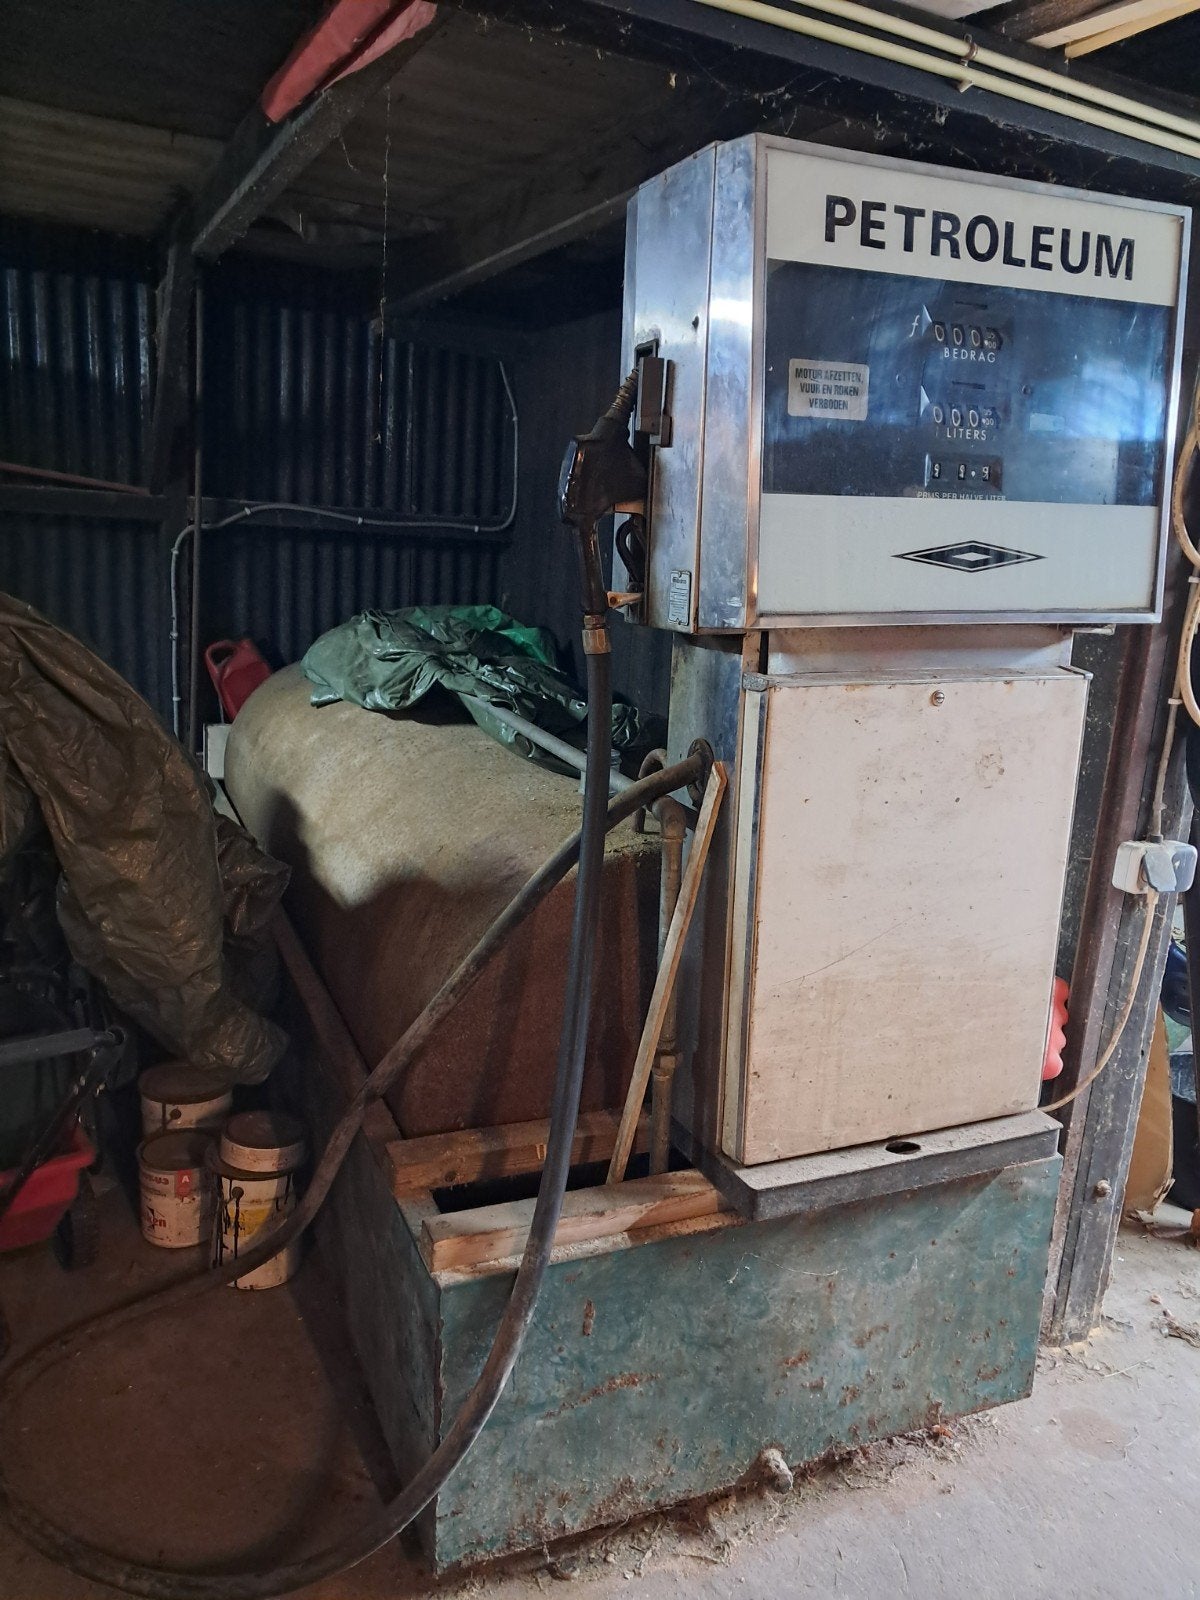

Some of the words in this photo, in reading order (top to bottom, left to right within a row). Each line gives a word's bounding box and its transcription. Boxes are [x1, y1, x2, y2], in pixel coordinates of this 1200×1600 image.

[825, 195, 1135, 280] PETROLEUM
[944, 347, 996, 363] BEDRAG
[795, 367, 823, 380] MOTOR
[800, 382, 820, 395] VUUR
[822, 384, 833, 396] EN
[834, 384, 859, 397] ROKEN
[809, 397, 849, 411] VERBODEN
[946, 427, 987, 441] LITERS
[942, 492, 958, 500] PER
[181, 1175, 190, 1184] A
